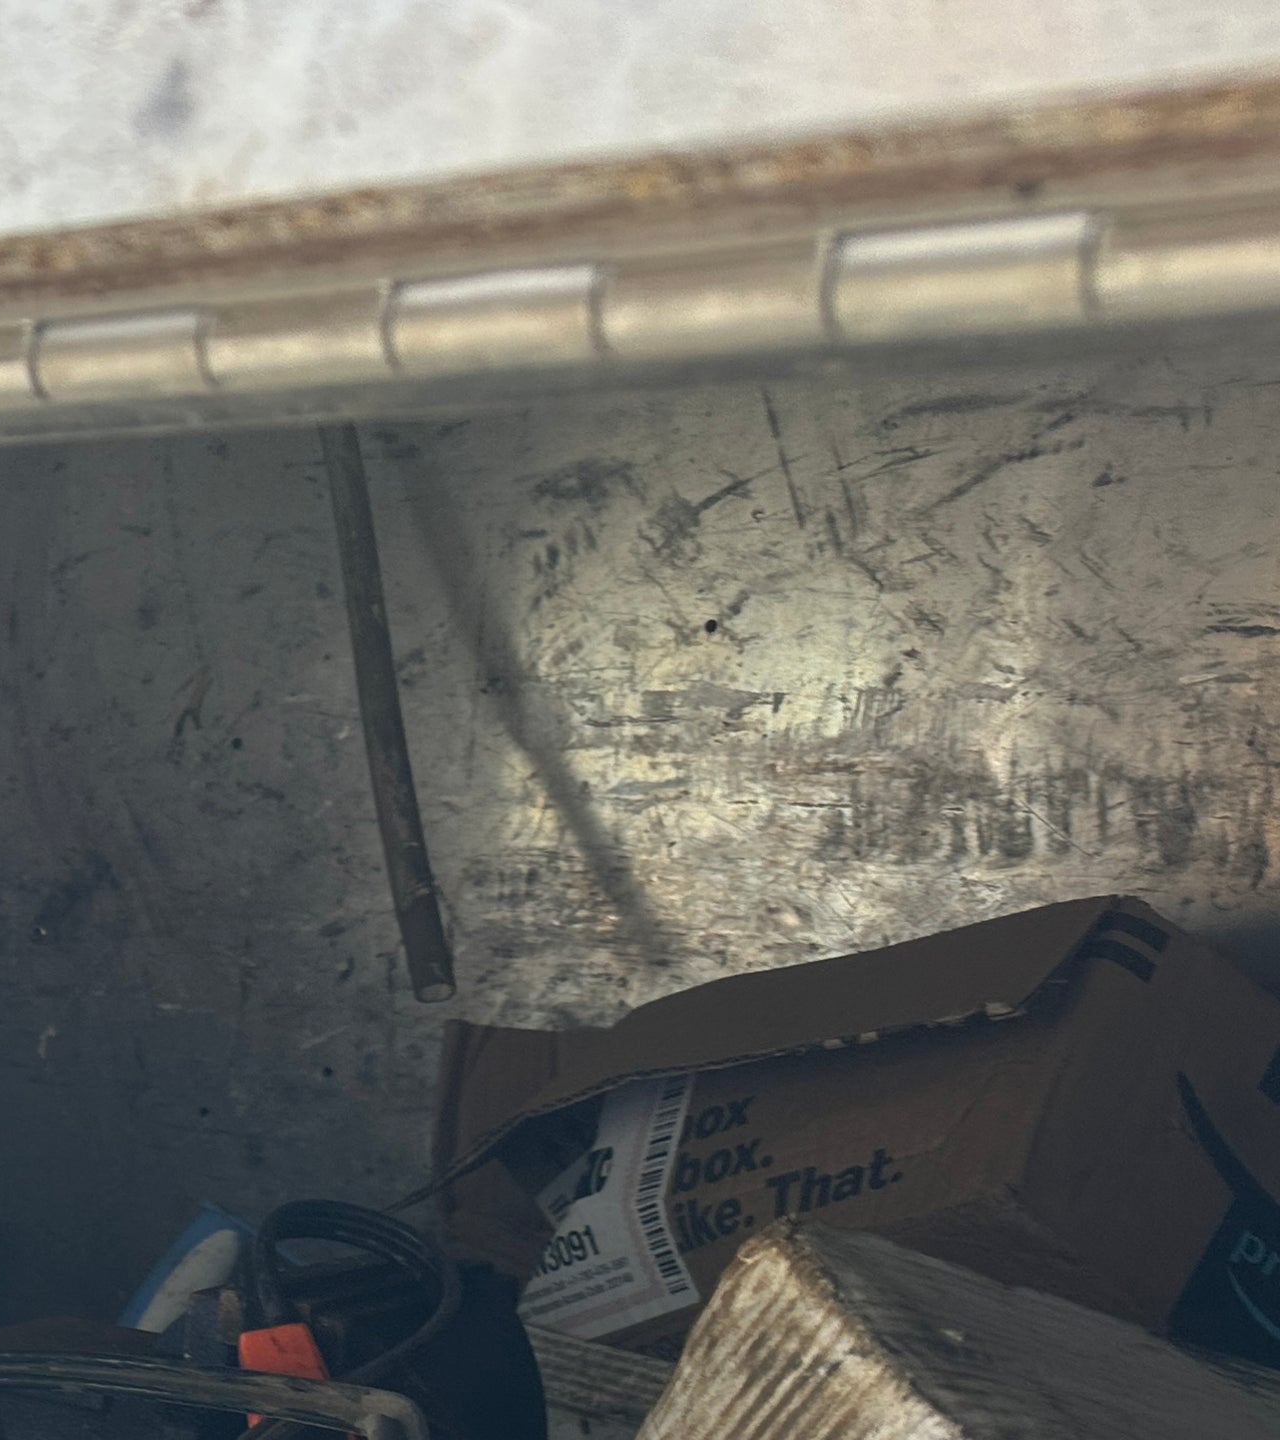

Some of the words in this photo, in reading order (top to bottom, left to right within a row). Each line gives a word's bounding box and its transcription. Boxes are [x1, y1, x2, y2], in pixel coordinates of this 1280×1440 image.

[672, 1138, 773, 1193] box.
[674, 1198, 755, 1252] ike.
[767, 1147, 904, 1219] That.
